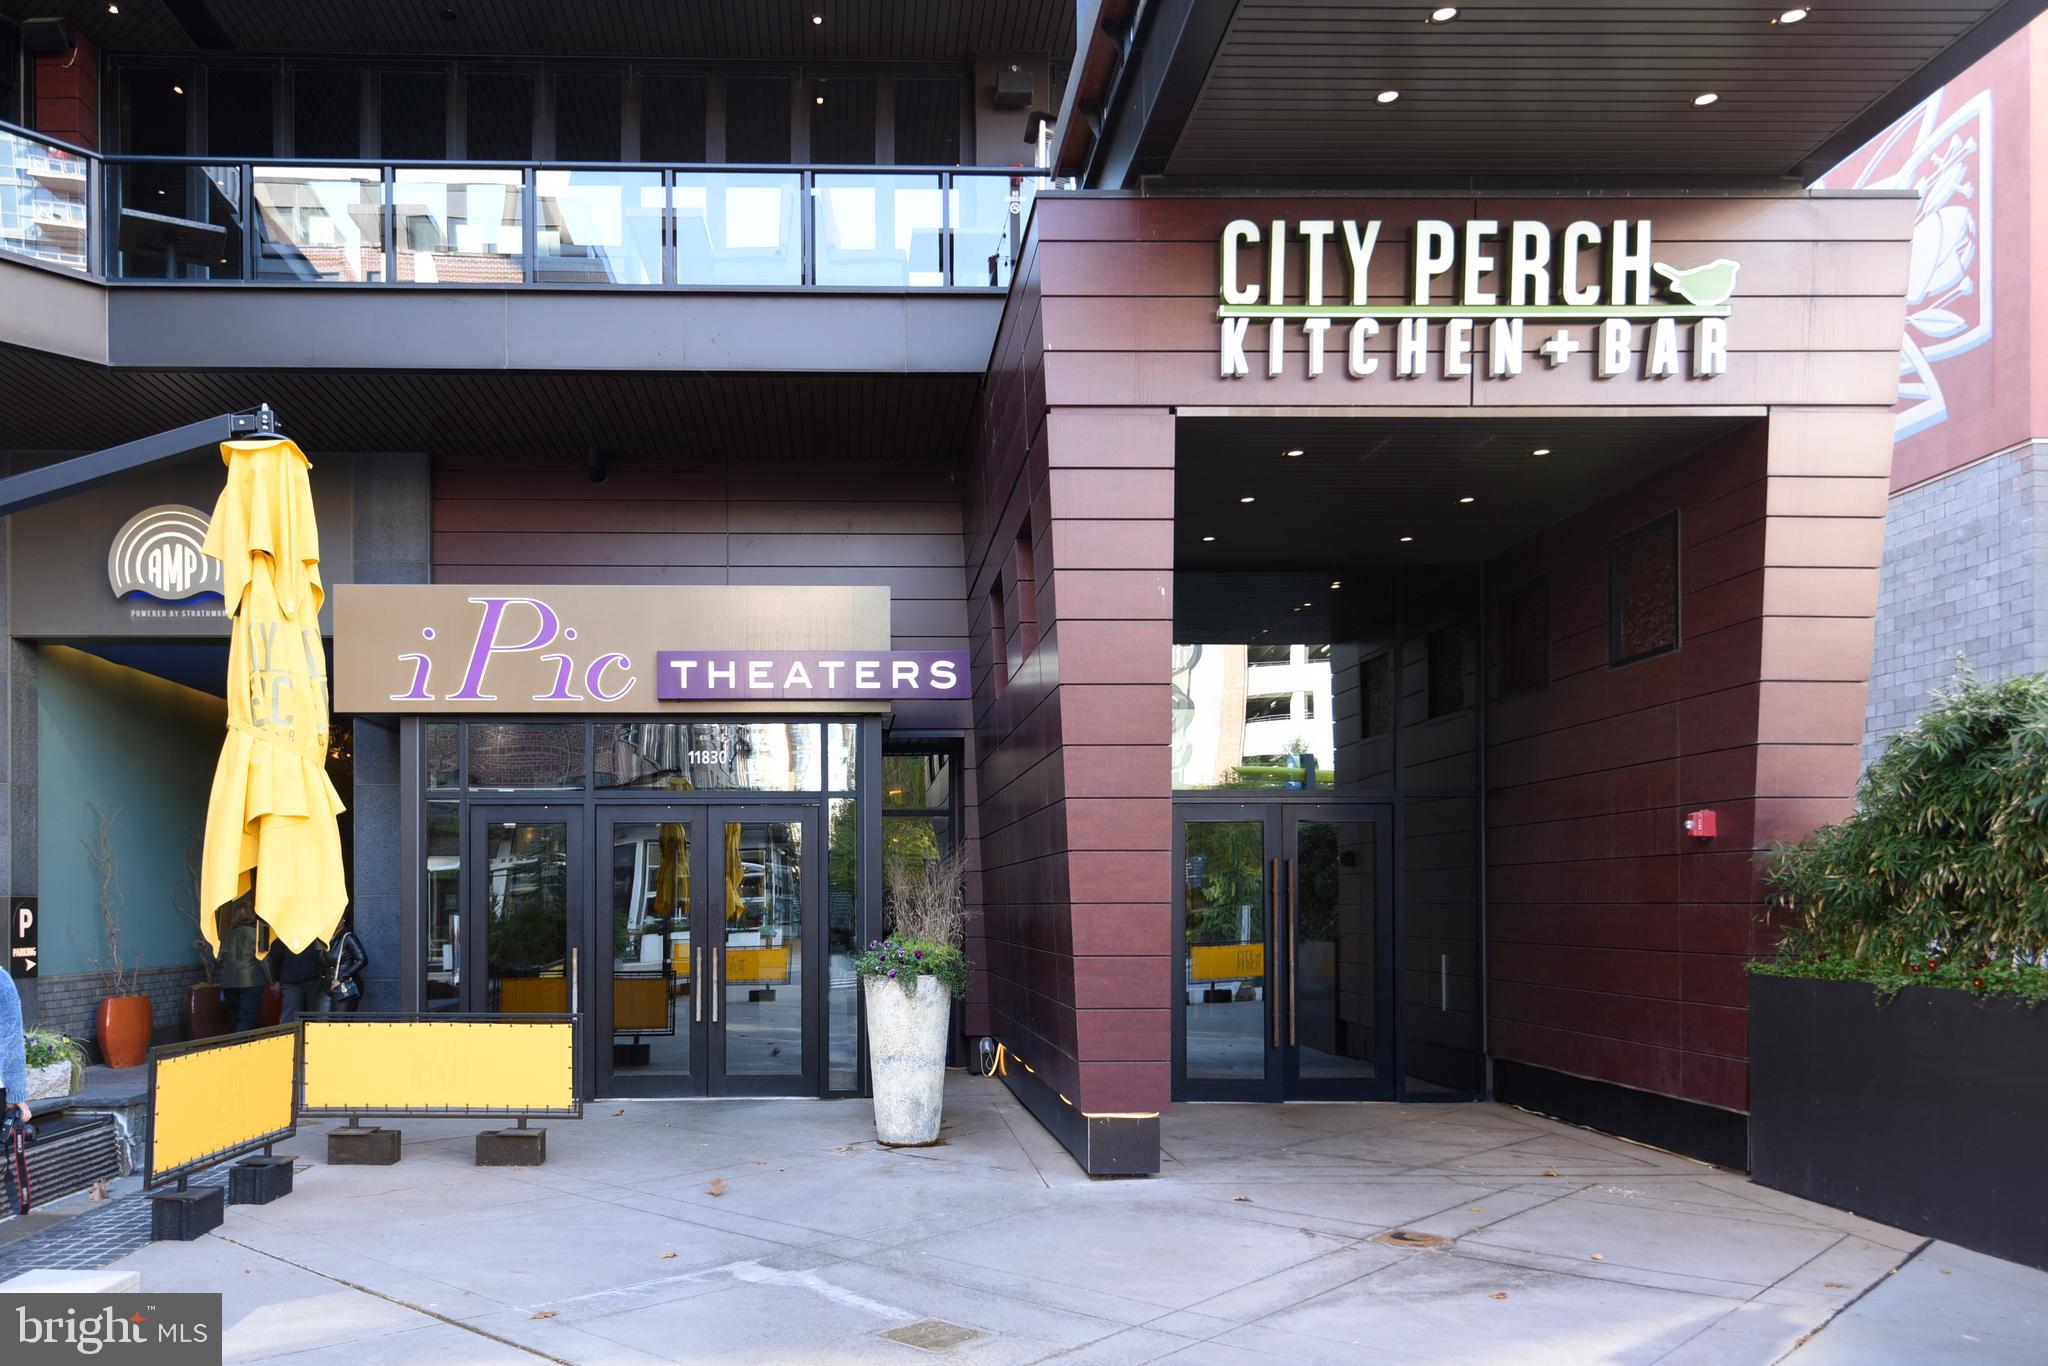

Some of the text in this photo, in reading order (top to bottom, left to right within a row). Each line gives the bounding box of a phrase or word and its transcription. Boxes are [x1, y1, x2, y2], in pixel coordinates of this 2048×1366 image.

[1220, 219, 1652, 306] CITY PERCH
[1219, 317, 1524, 378] KITCHEN
[1598, 317, 1728, 378] BAR
[148, 543, 198, 592] AMP
[131, 609, 167, 617] POWERED
[169, 609, 179, 617] BY
[389, 596, 638, 703] iPic
[669, 659, 959, 690] THEATERS
[688, 750, 727, 765] 11830
[19, 908, 33, 938] P
